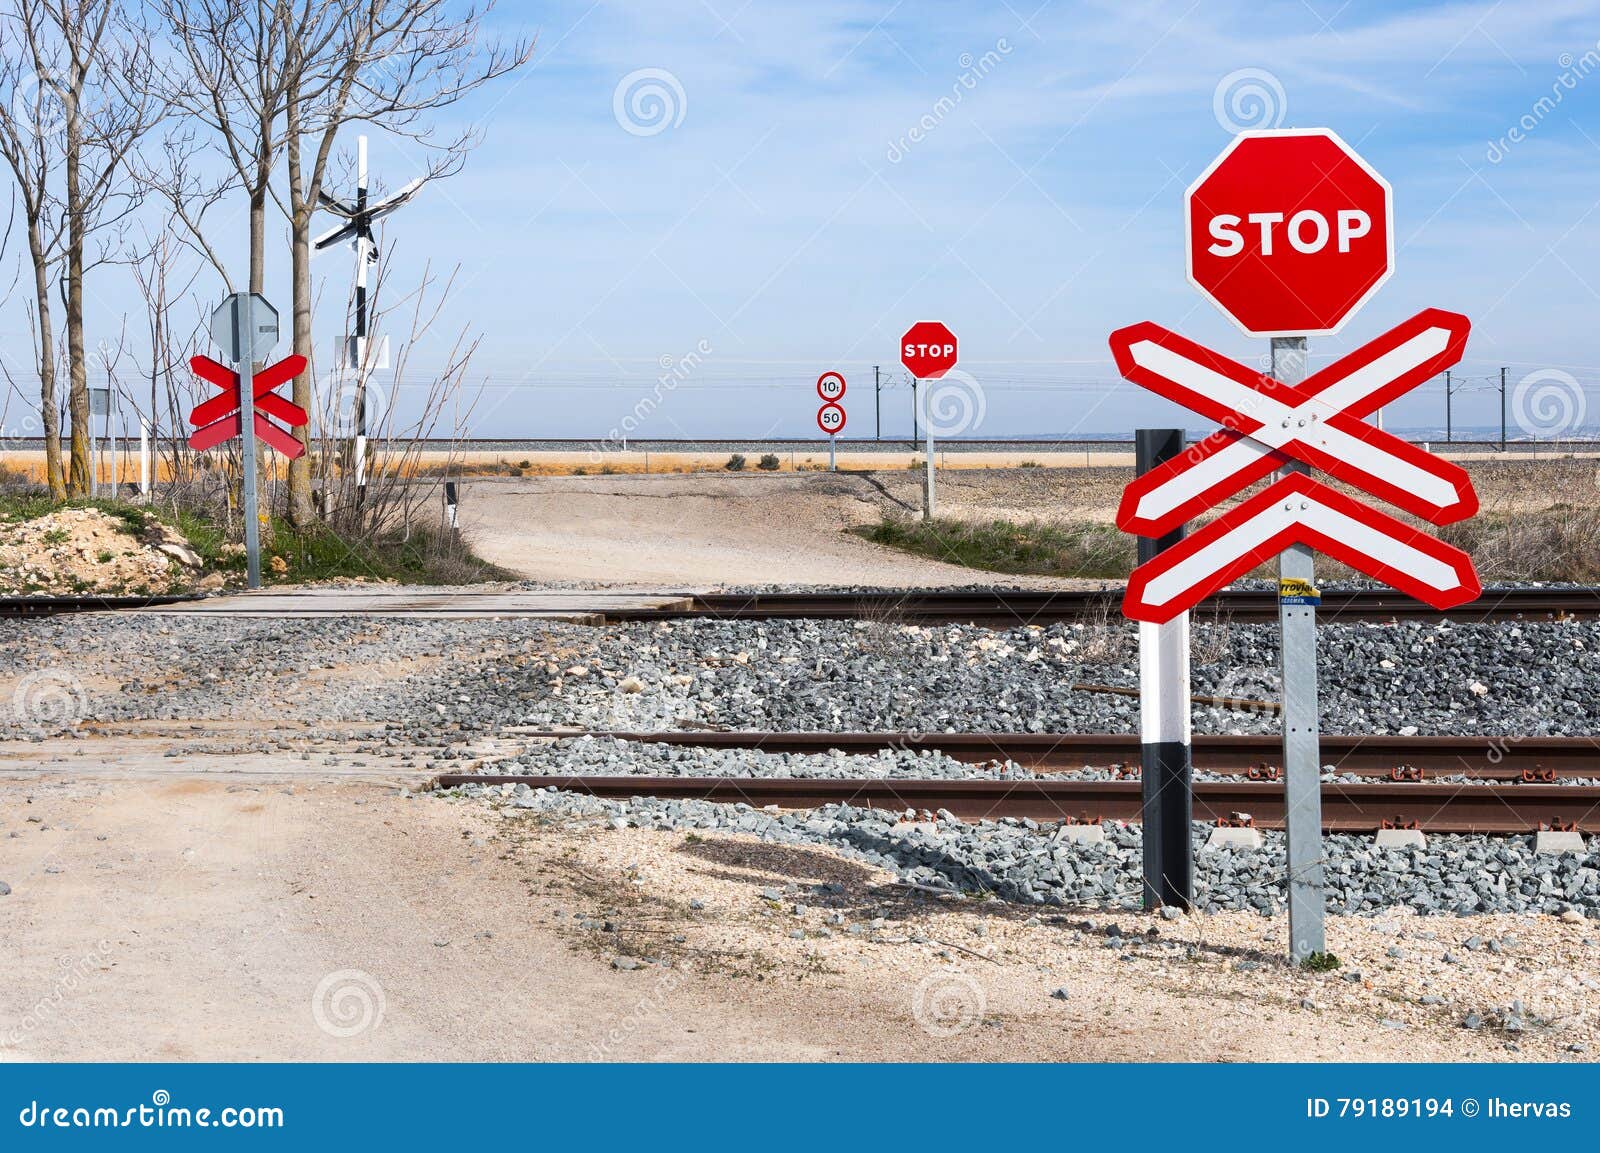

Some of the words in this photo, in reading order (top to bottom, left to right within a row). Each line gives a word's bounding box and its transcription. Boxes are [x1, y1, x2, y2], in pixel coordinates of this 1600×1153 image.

[1207, 209, 1372, 257] STOP
[904, 344, 954, 358] STOP
[823, 381, 840, 392] 10t
[823, 412, 840, 424] 50
